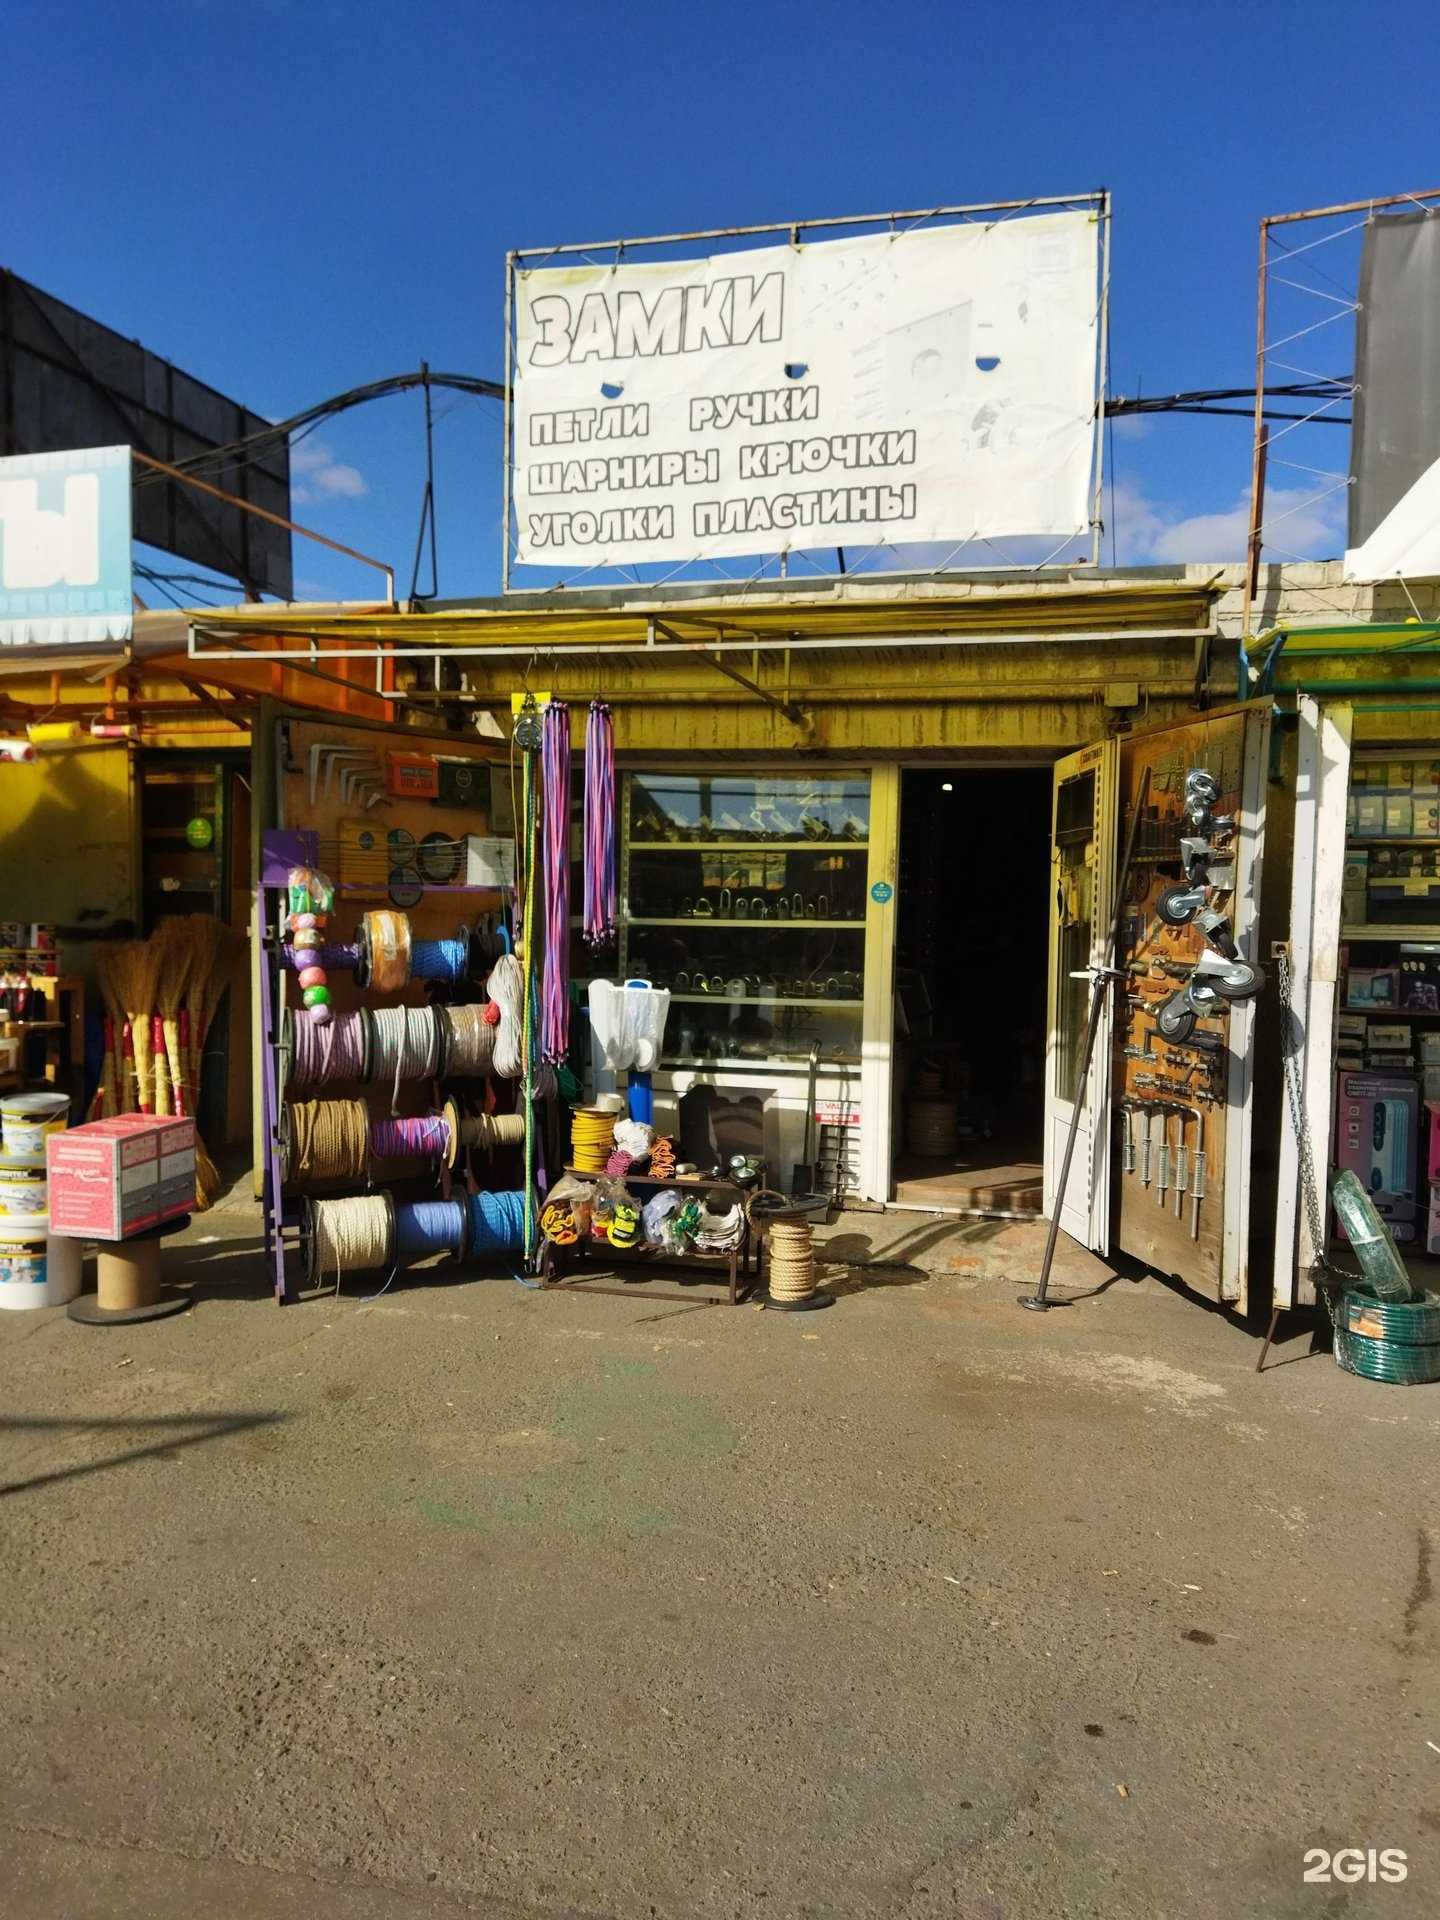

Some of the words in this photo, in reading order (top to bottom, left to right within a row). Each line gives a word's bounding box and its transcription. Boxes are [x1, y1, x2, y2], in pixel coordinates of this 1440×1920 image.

[529, 271, 784, 367] ЗАМКИ
[530, 403, 650, 446] ПЕТЛИ
[689, 386, 819, 431] РУЧКИ
[528, 448, 719, 495] ШАРНИРЫ
[740, 430, 916, 479] КРЮЧКИ
[529, 505, 674, 547] УГОЛКИ
[693, 484, 916, 537] ПЛАСТИНЫ
